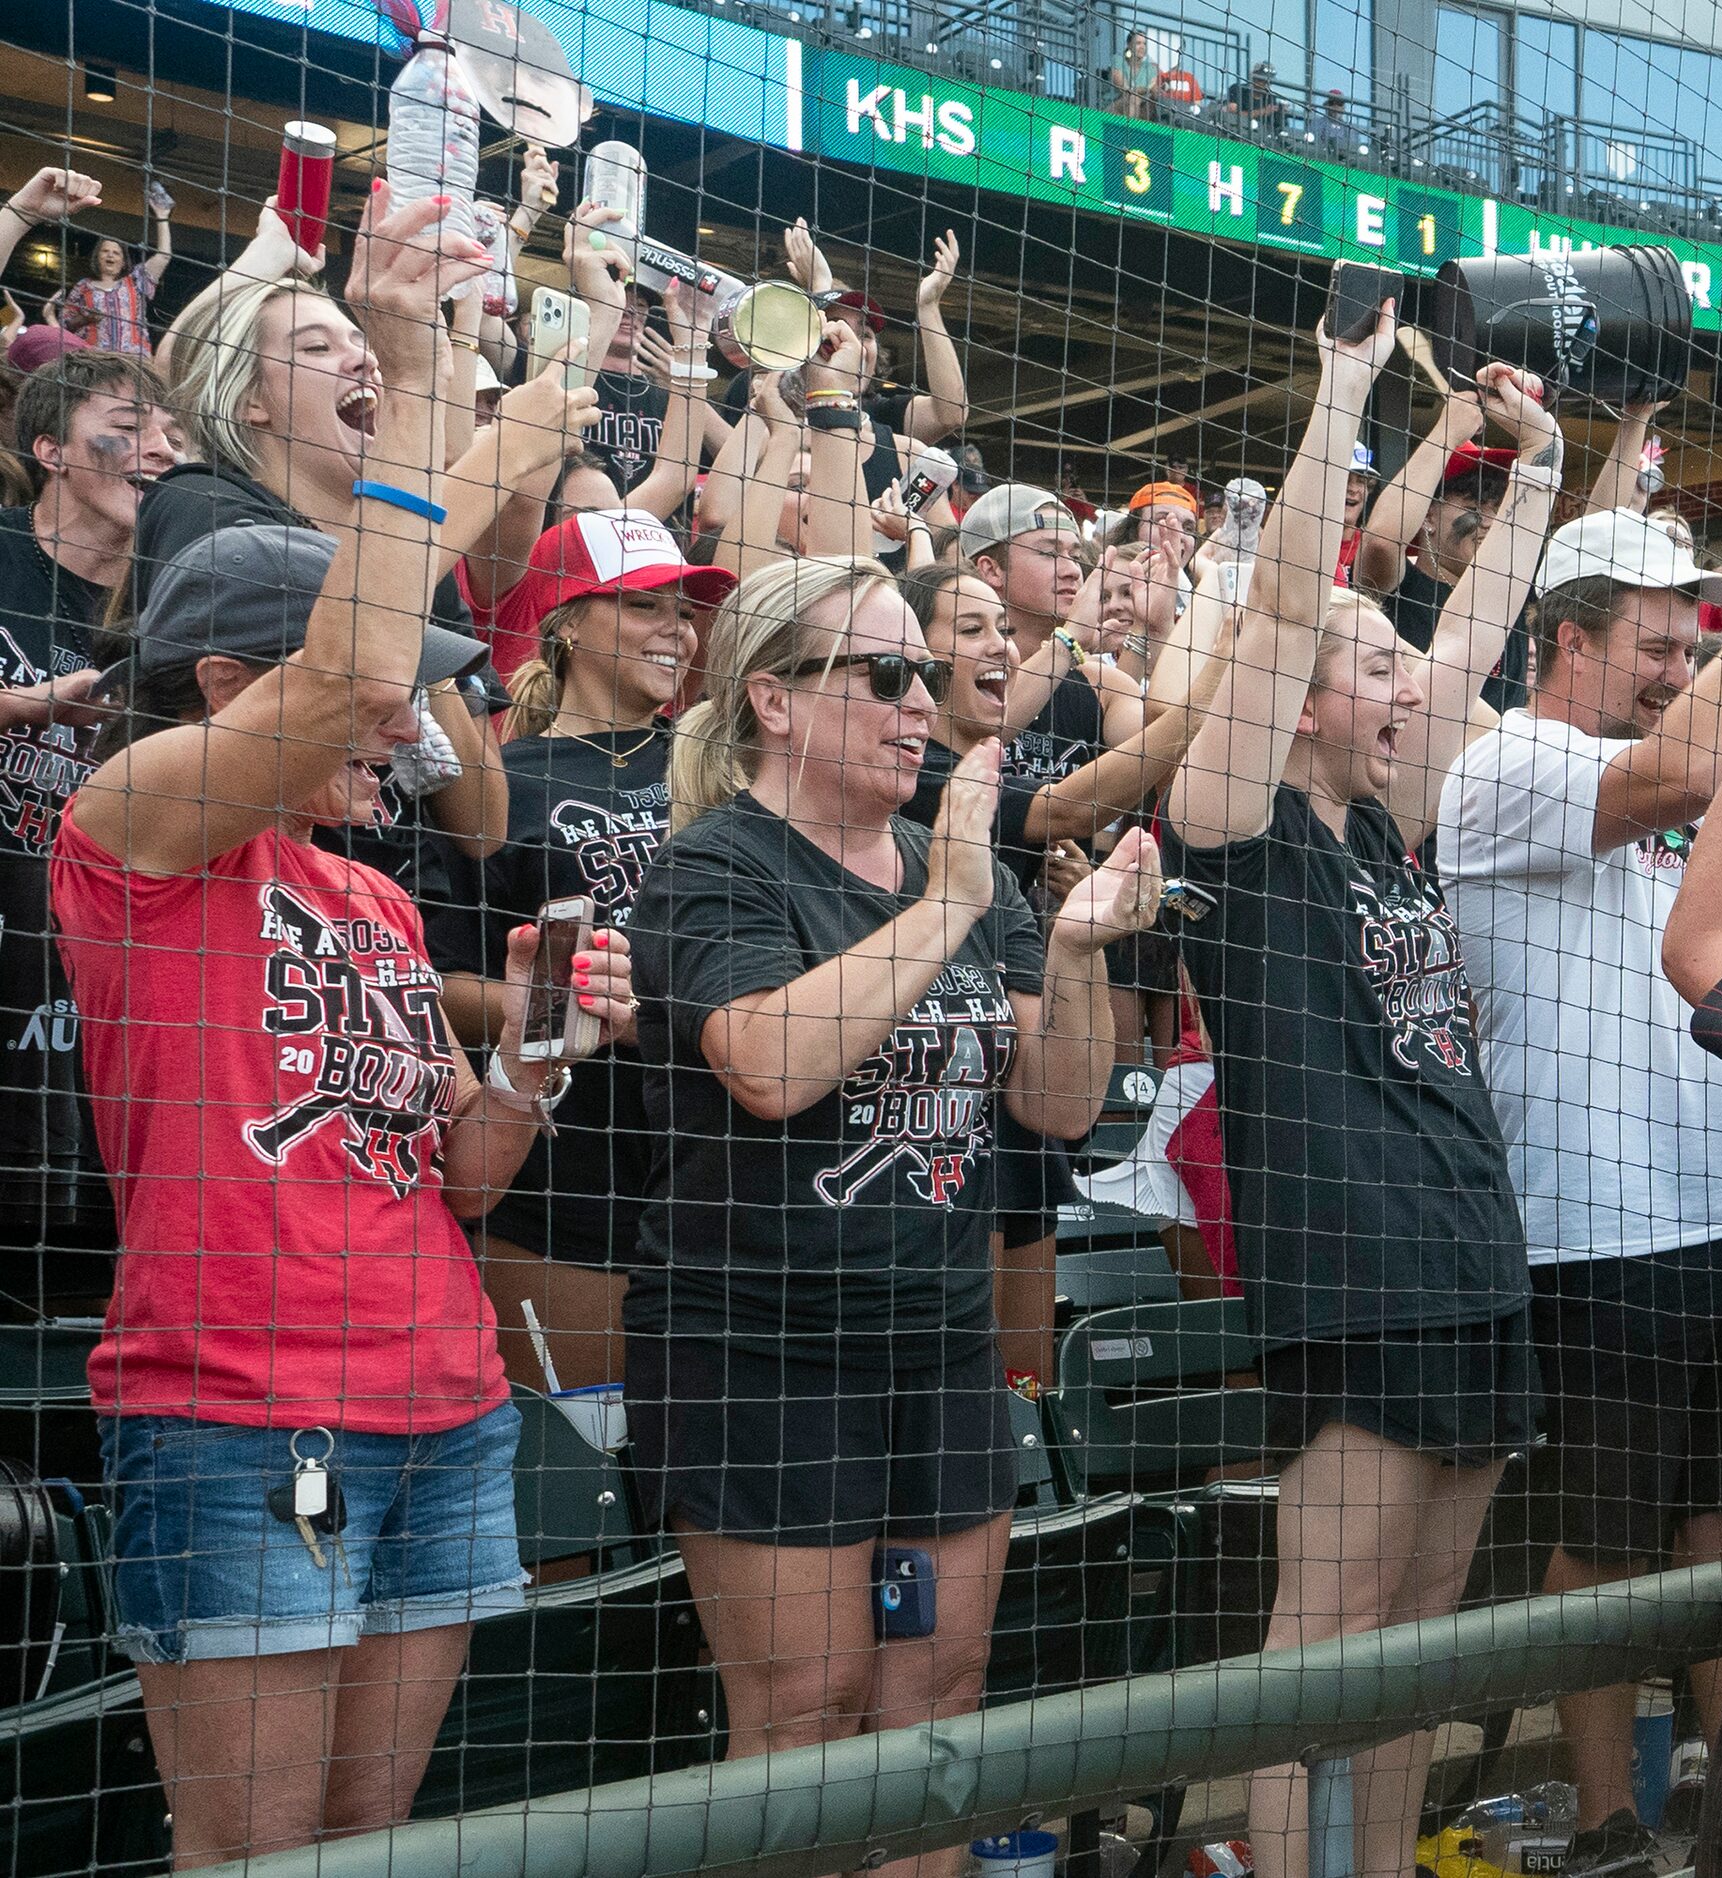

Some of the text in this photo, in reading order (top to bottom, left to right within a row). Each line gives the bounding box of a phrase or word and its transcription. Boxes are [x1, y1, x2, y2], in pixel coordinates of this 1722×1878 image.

[846, 78, 1436, 255] KHS R 3 H 7 E 1
[1682, 260, 1712, 310] R
[1543, 273, 1563, 349] OUTOORS
[560, 811, 659, 845] HEATH
[278, 1046, 315, 1075] 20
[848, 1104, 876, 1125] 20
